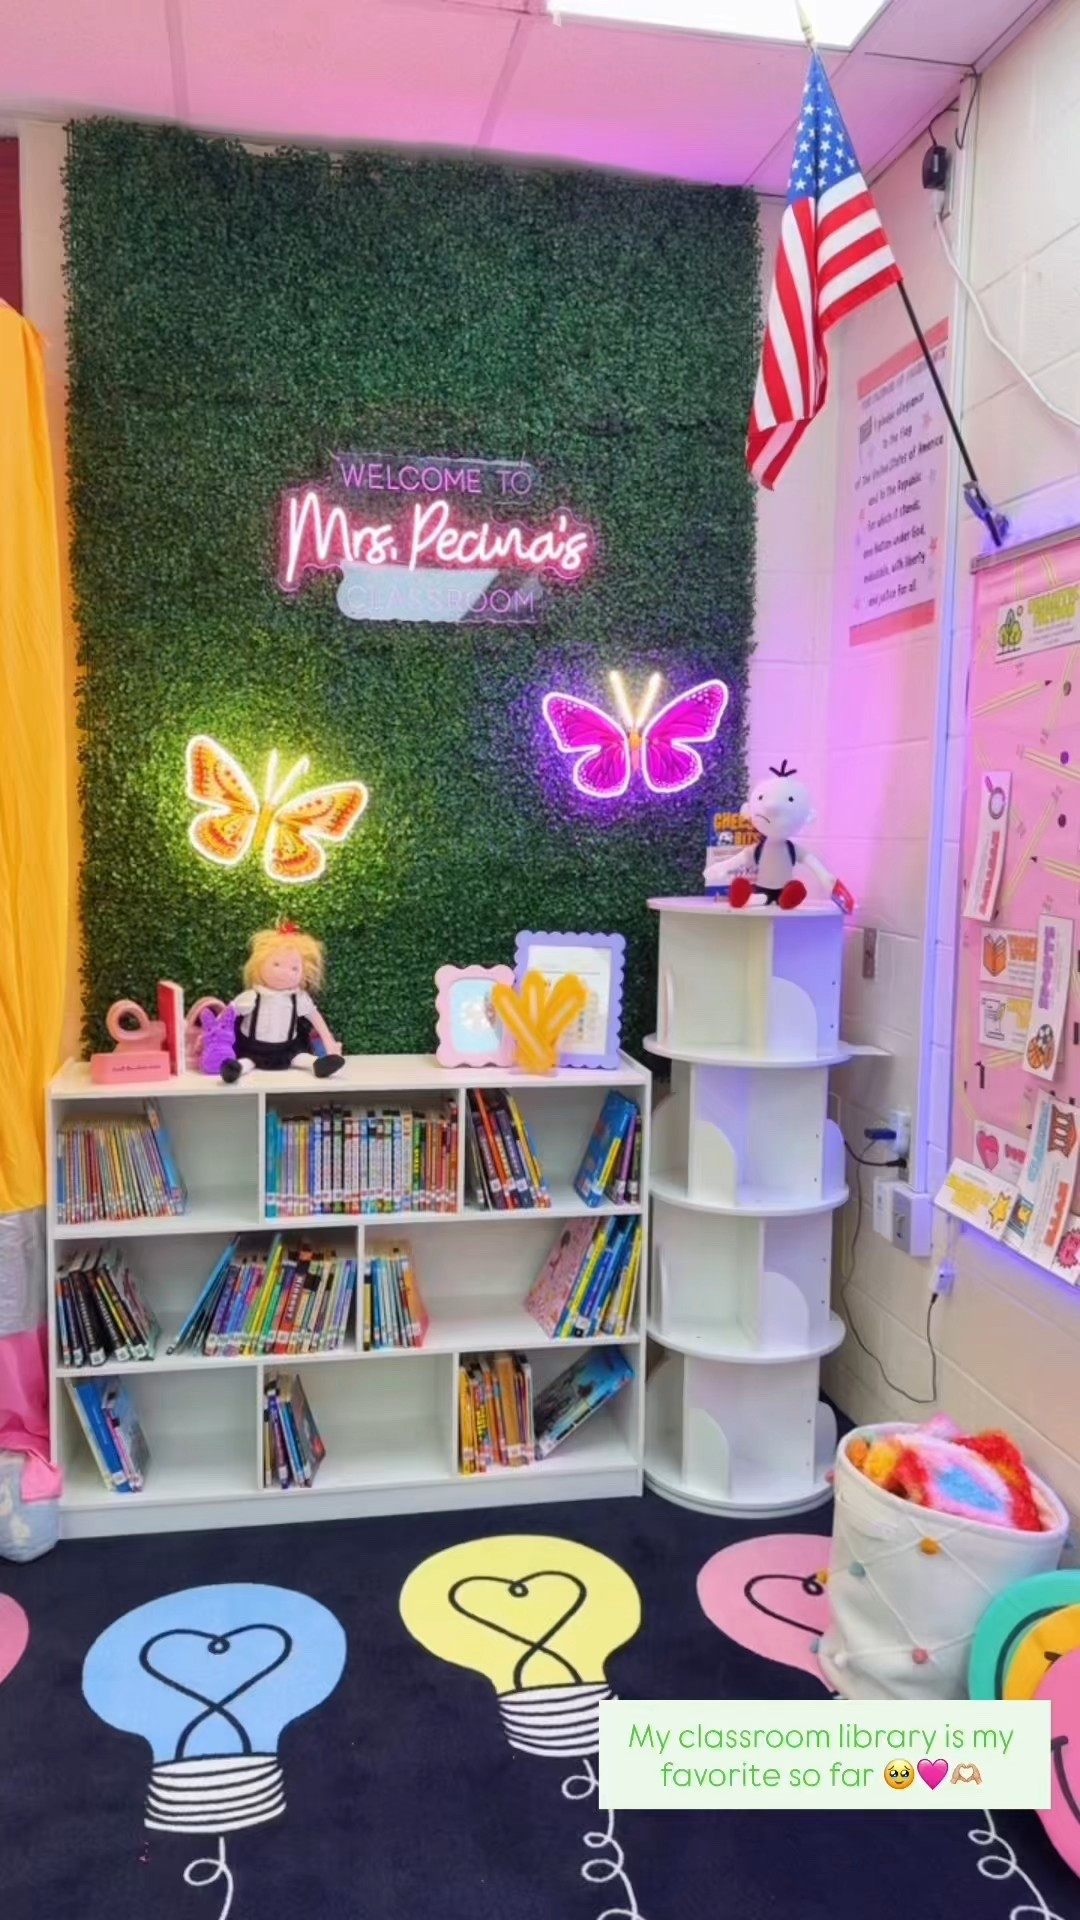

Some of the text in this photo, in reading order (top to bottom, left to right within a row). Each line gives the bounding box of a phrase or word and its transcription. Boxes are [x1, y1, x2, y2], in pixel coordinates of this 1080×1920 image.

[918, 434, 944, 455] America
[340, 463, 532, 494] WELCOME TO
[346, 586, 535, 613] CLASSROOM
